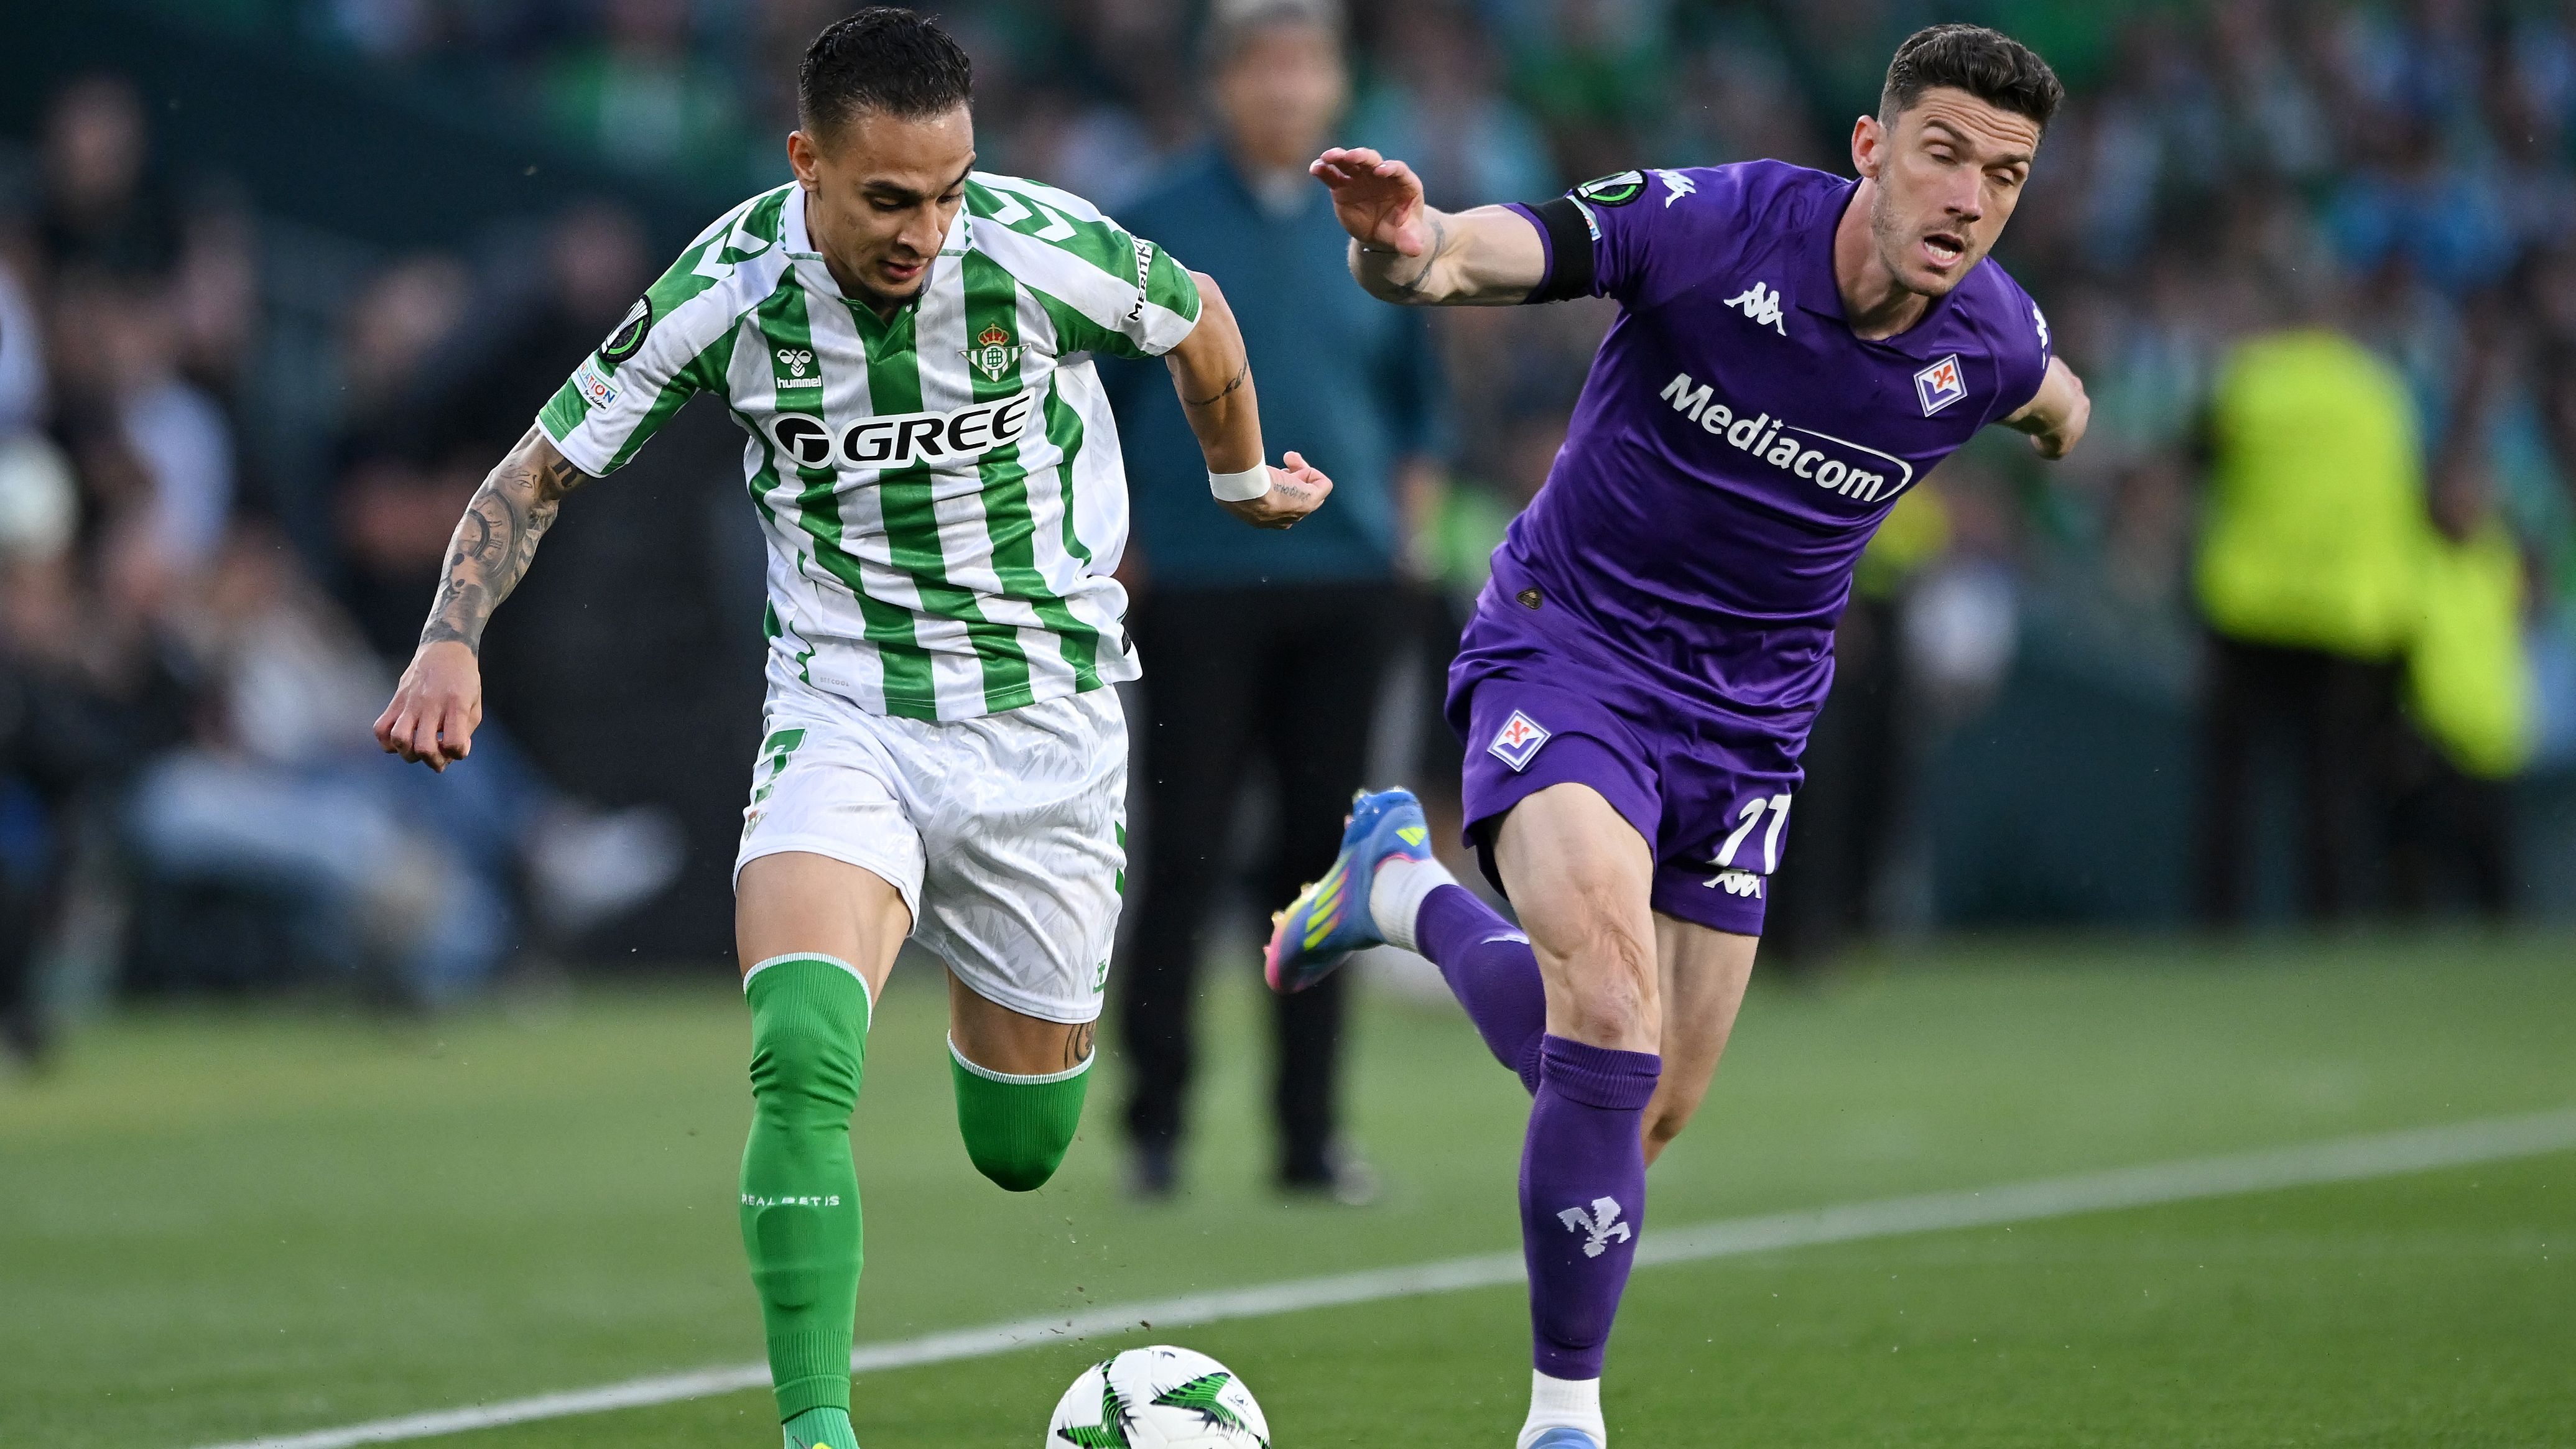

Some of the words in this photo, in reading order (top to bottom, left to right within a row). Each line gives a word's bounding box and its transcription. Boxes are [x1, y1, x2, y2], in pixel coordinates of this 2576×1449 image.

[776, 375, 822, 389] hummel
[843, 395, 1031, 462] GREE
[1659, 373, 1884, 502] Mediacom
[741, 1193, 776, 1206] REAL
